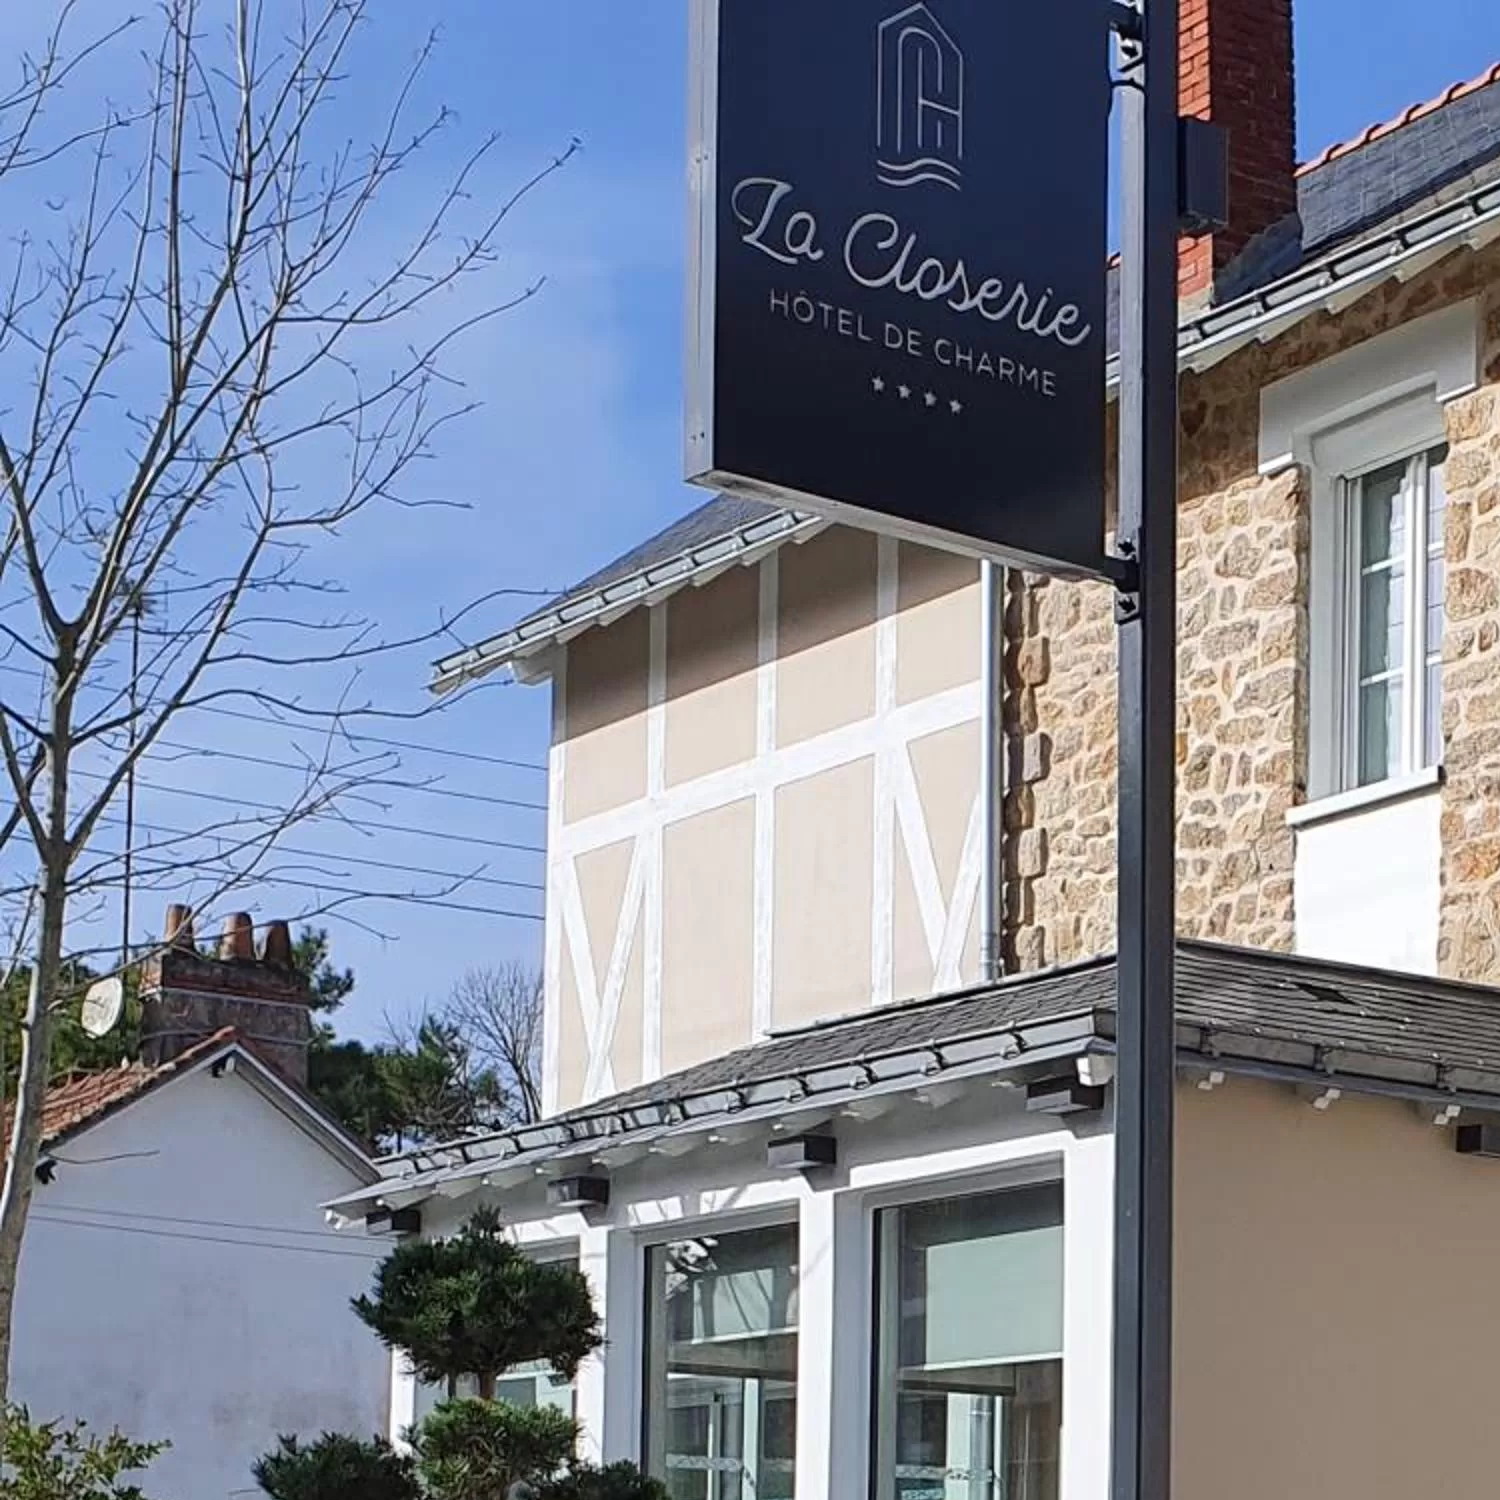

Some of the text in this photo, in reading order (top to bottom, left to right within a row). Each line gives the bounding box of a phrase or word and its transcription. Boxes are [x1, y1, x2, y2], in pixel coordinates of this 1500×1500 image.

[731, 177, 1091, 346] La Closerie
[769, 287, 1058, 397] HÔTEL DE CHARME
